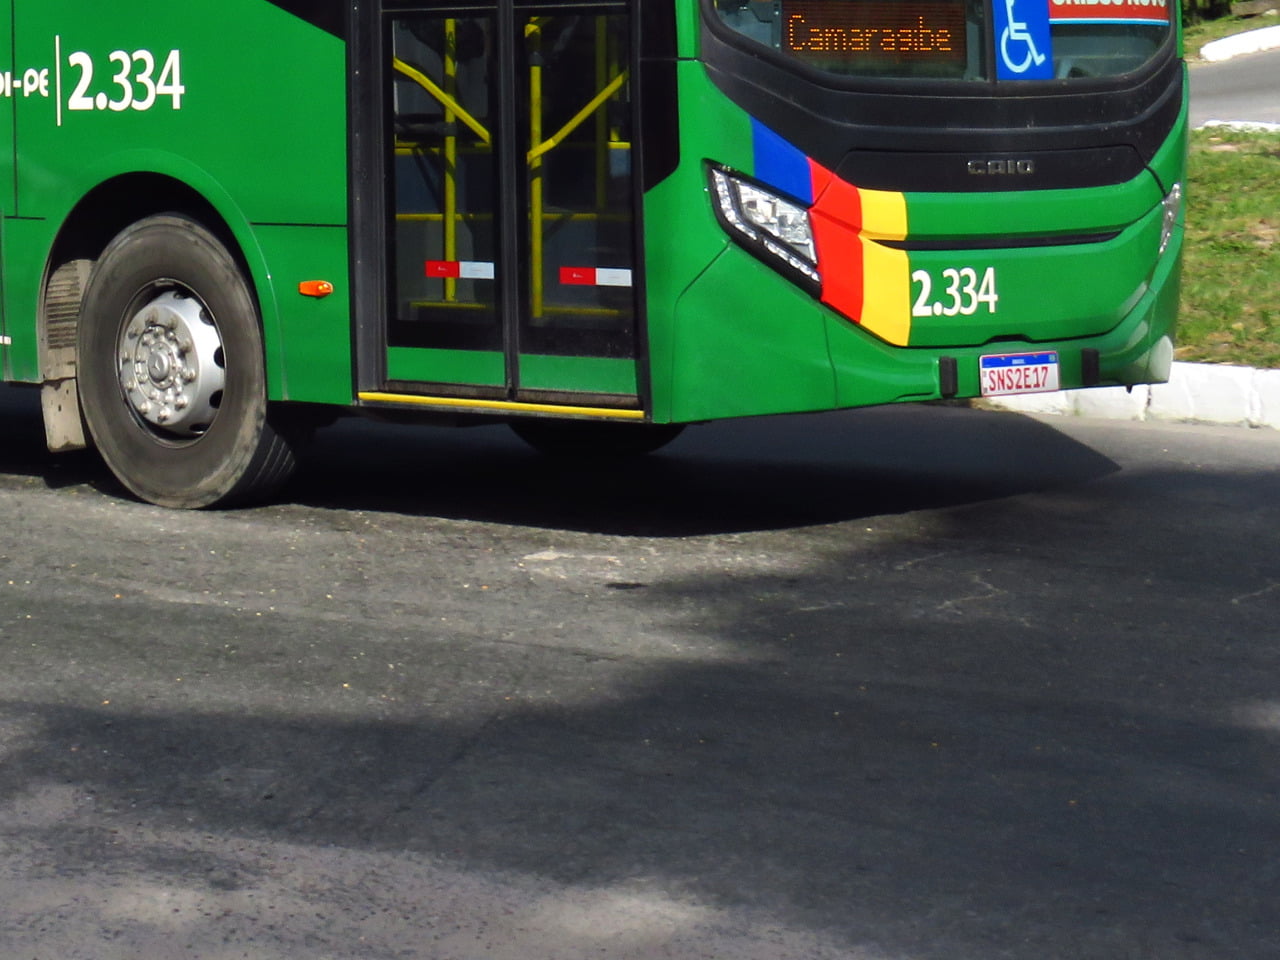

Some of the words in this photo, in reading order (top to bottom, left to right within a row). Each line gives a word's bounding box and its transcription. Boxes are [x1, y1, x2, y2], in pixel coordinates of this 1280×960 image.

[789, 15, 952, 51] Camaragibe
[67, 48, 186, 112] 2.334
[967, 159, 1035, 175] CAIO
[911, 266, 999, 318] 2.334
[988, 366, 1049, 392] SNS2E17
